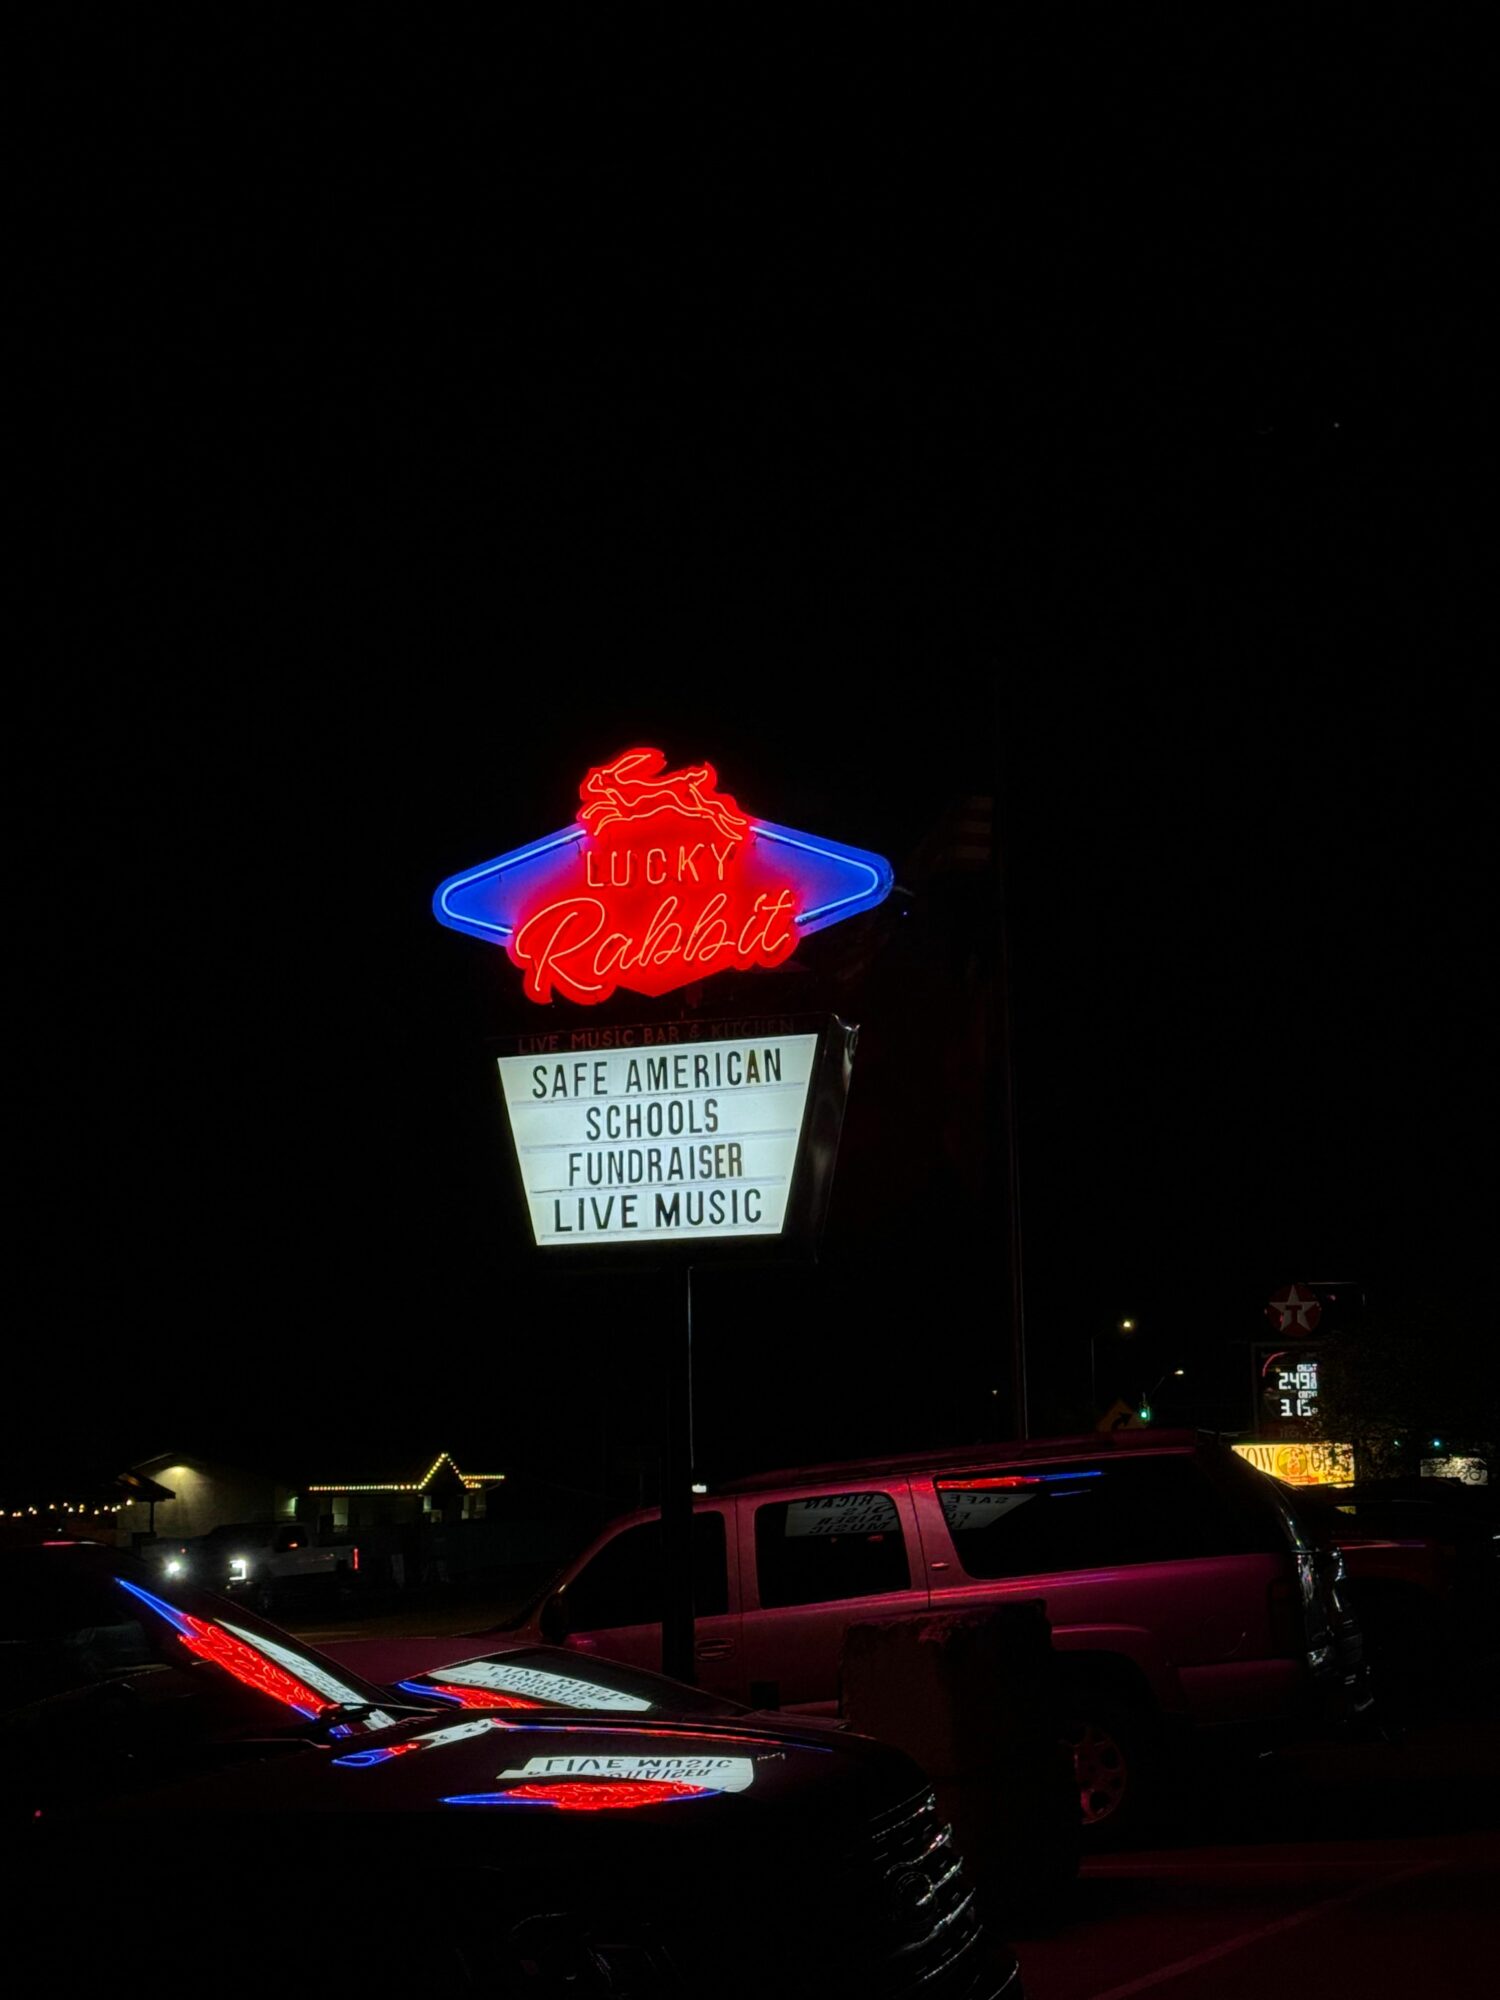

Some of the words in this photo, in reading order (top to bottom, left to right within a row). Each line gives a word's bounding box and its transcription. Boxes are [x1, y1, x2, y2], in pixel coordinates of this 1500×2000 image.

[586, 841, 735, 887] LUCKY
[515, 889, 793, 992] Rabbit
[517, 1034, 560, 1055] LIVE
[570, 1028, 635, 1050] MUSIC
[643, 1025, 680, 1045] BAR
[710, 1016, 795, 1038] KITCHEN
[532, 1061, 608, 1099] SAFE
[625, 1048, 783, 1093] AMERICAN
[586, 1098, 719, 1141] SCHOOLS
[568, 1142, 743, 1187] FUNDRAISER
[554, 1194, 638, 1232] LIVE
[655, 1188, 762, 1228] MUSIC
